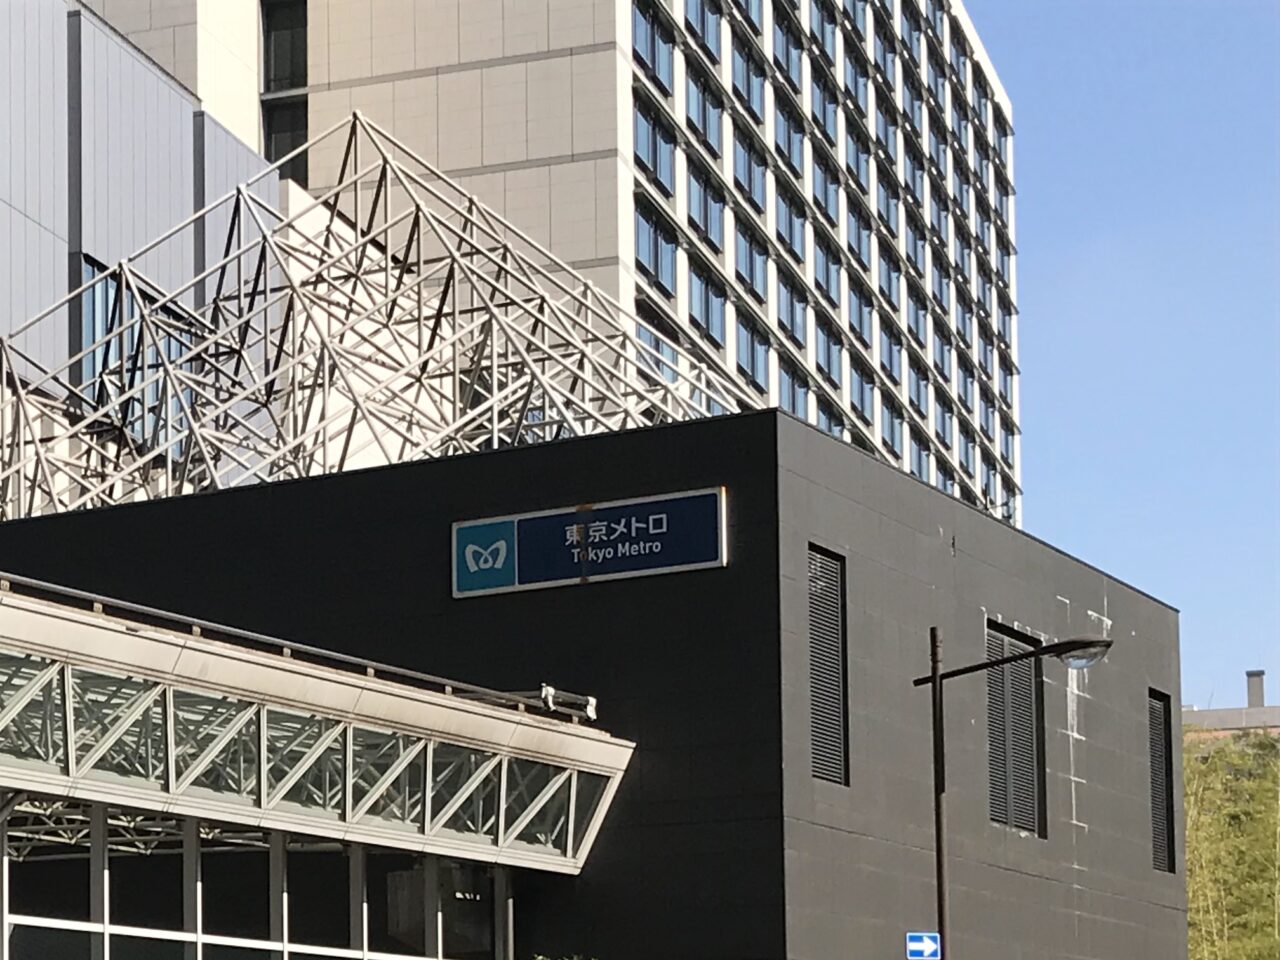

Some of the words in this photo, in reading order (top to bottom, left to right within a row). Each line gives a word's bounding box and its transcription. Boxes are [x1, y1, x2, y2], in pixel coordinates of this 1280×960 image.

[565, 513, 667, 546] 東京メトロ
[571, 546, 614, 563] Tokyo
[617, 541, 662, 557] Metro
